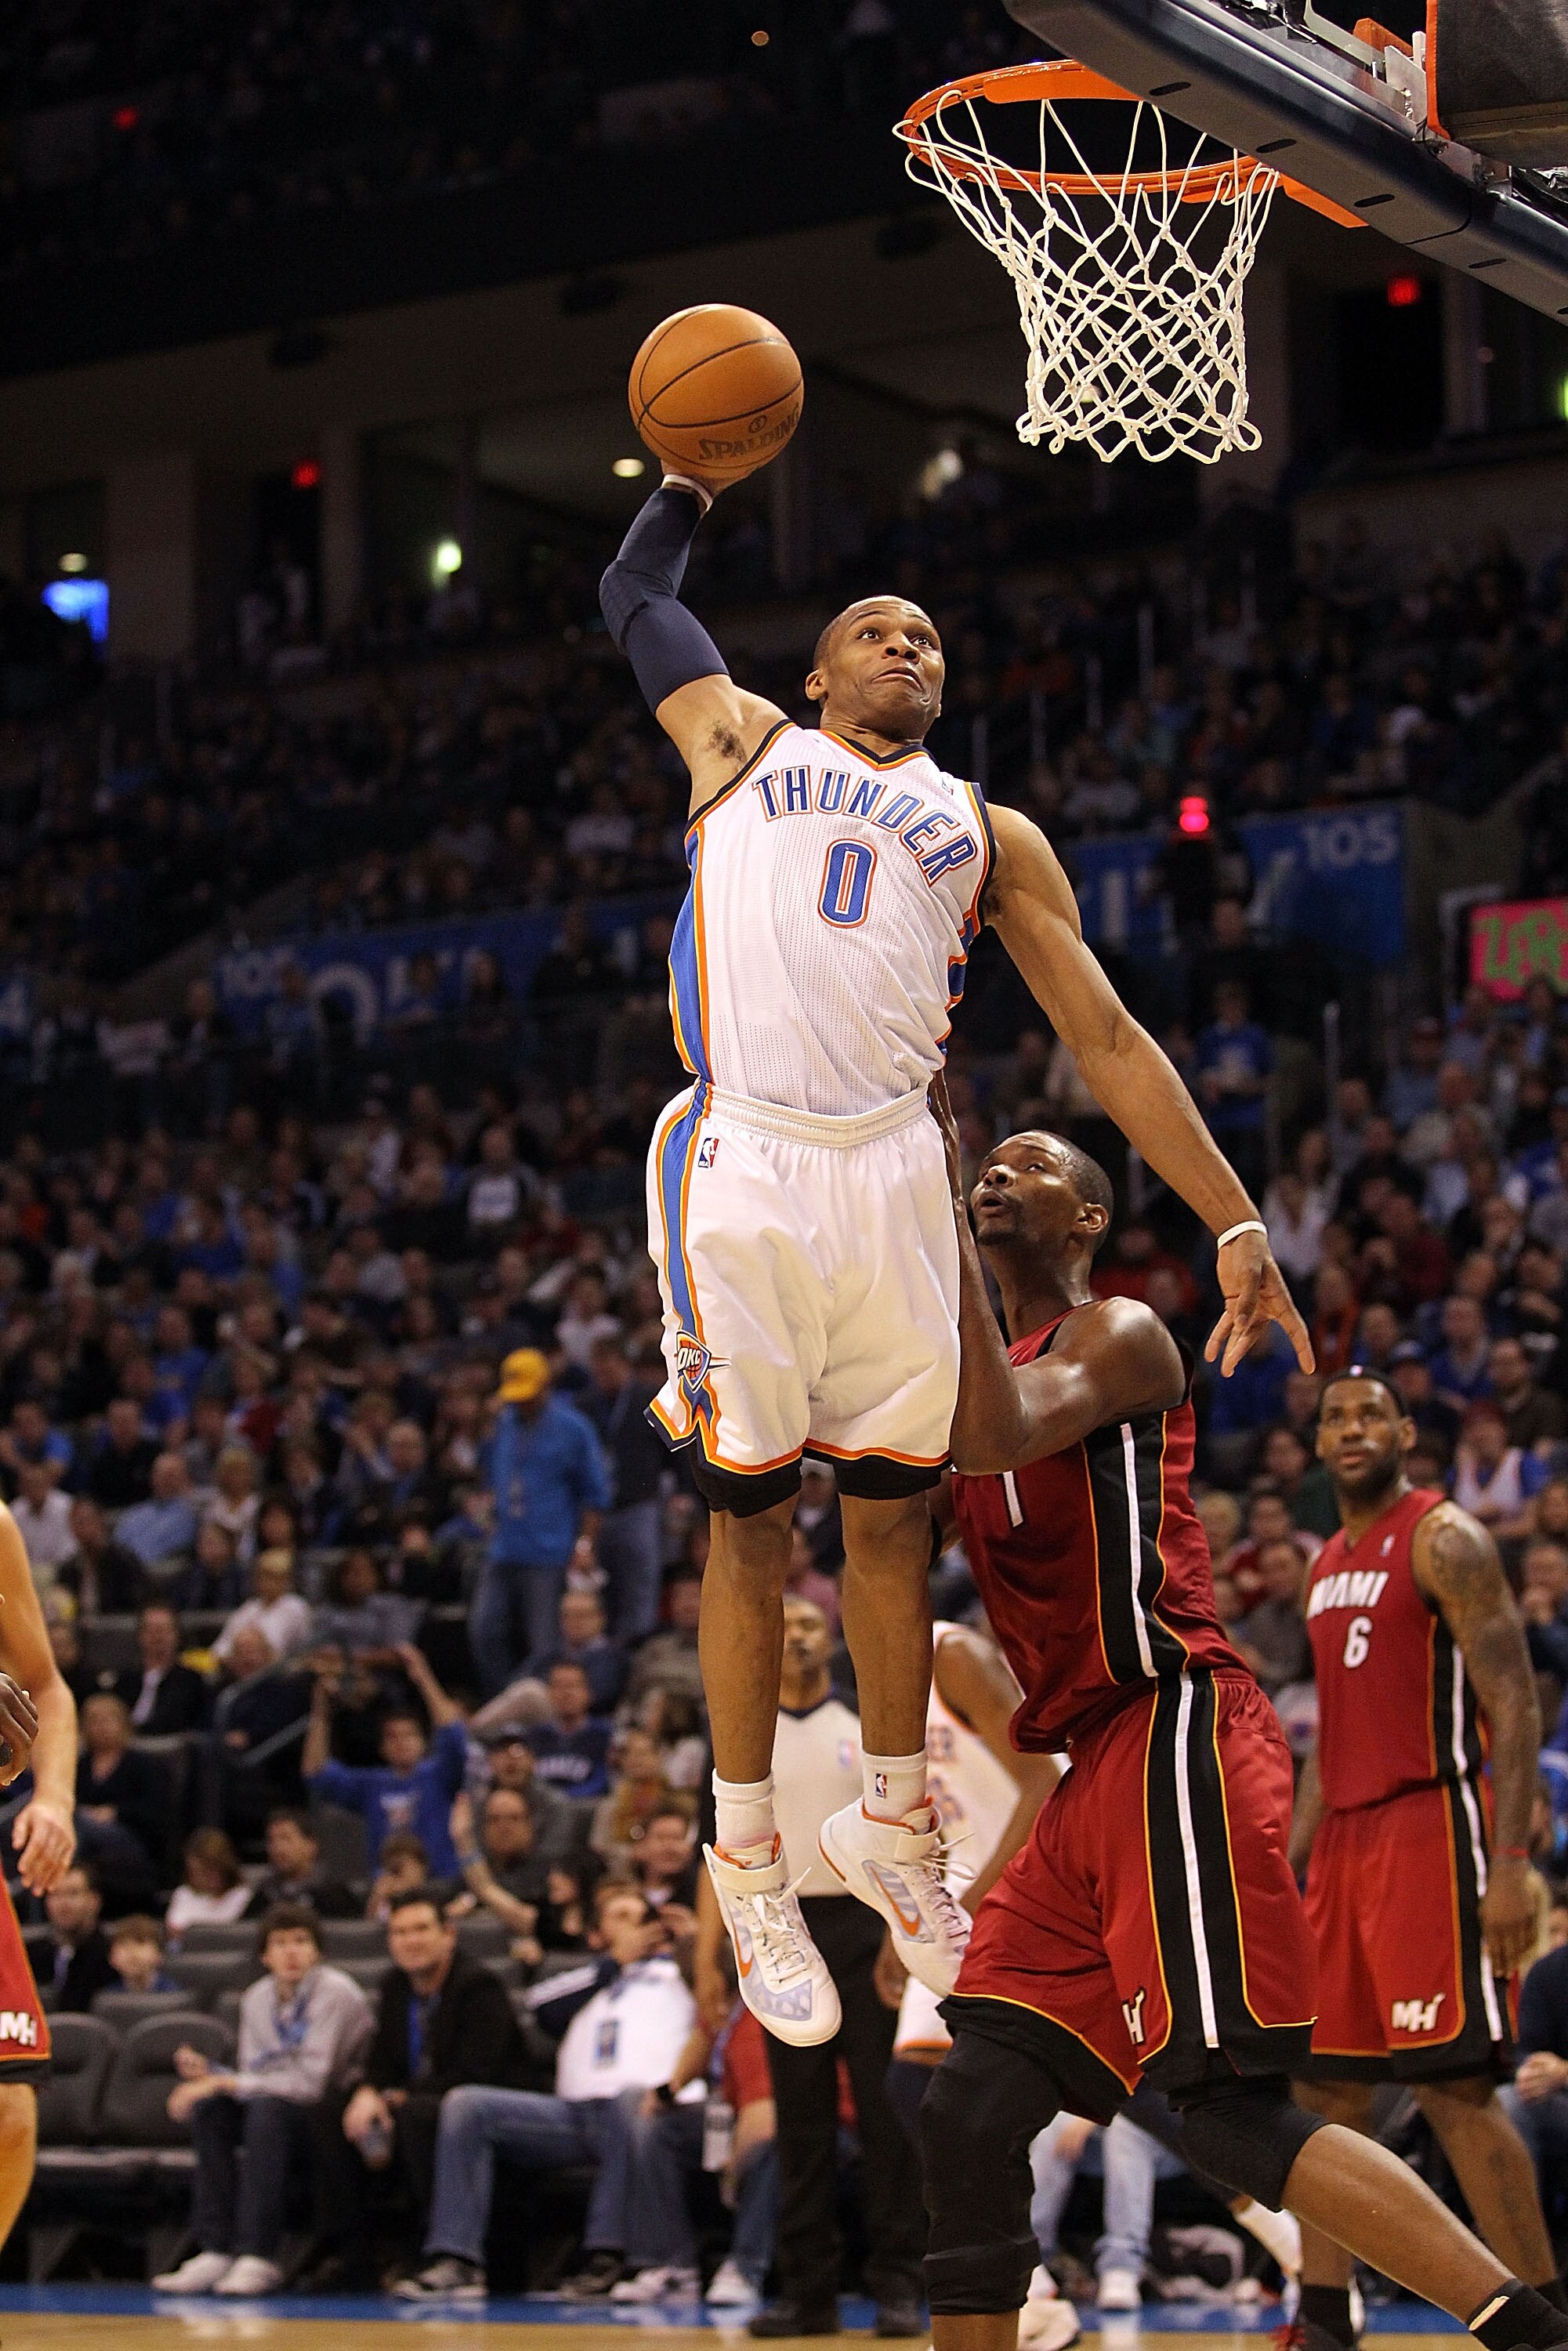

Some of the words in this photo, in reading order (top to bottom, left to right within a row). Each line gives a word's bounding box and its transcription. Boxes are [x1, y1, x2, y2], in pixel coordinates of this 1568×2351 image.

[699, 401, 799, 460] SPALDING
[751, 765, 978, 888] THUNDER
[1302, 812, 1401, 874] 105
[818, 838, 878, 929] 0
[677, 1347, 702, 1371] OKC
[1306, 1570, 1389, 1620] MIAMI
[1343, 1615, 1372, 1669] 6
